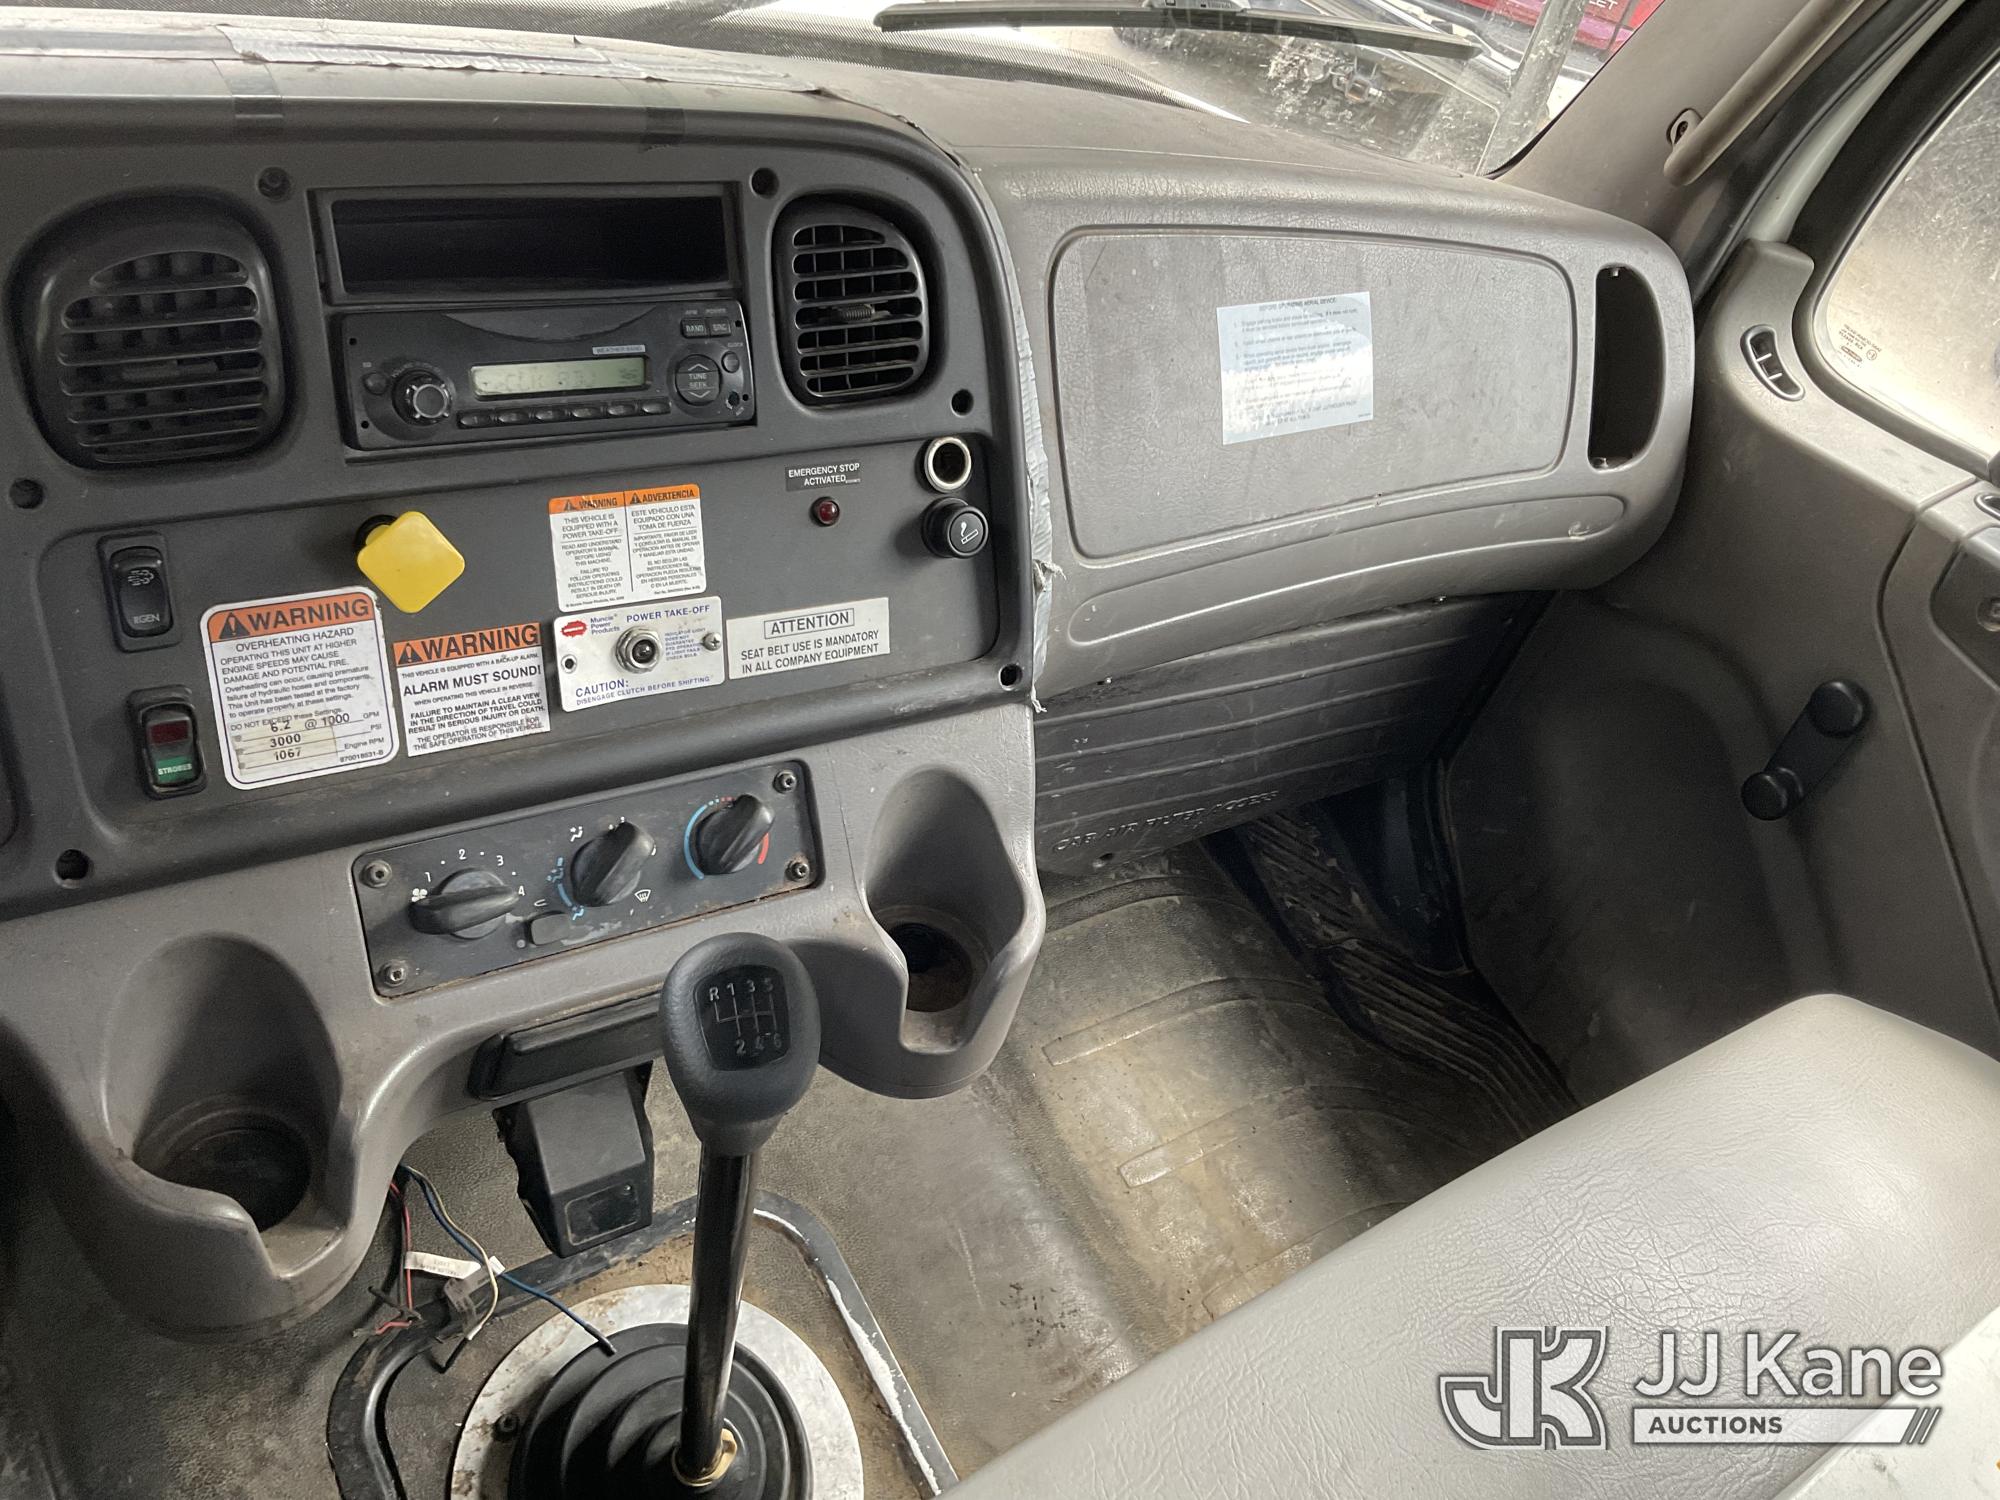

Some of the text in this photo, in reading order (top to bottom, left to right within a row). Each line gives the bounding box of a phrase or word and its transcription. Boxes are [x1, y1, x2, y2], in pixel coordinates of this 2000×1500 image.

[788, 463, 859, 477] EMERGENCY STOP
[804, 475, 846, 486] ACTIVATED
[643, 490, 695, 502] ADVERTENCIA
[580, 514, 607, 522] VEHICLE
[634, 515, 665, 524] EQUIPADO
[649, 506, 679, 515] VEHICULO
[562, 523, 594, 532] EQUIPPED
[563, 527, 618, 539] POWER TAKE-OFF
[668, 519, 691, 527] FUERZA
[248, 599, 369, 631] WARNING
[626, 605, 710, 623] POWER TAKE-OFF
[771, 612, 849, 635] ATTENTION
[236, 626, 354, 654] OVERHEATING HAZARD
[591, 626, 620, 635] Products
[221, 637, 357, 666] OPERATING THIS UNIT AT HIGHER
[421, 625, 539, 660] WARNING
[741, 630, 878, 661] SEAT BELT USE IS MANDATORY
[222, 650, 339, 675] ENGINE SPEEDS MAY CAUSE
[415, 668, 439, 676] VEHICLE
[447, 662, 475, 671] EQUIPPED
[496, 656, 519, 664] BACK-UP
[742, 643, 879, 674] IN ALL COMPANY EQUIPMENT
[224, 658, 348, 685] DAMAGE AND POTENTIAL FIRE.
[226, 680, 267, 695] Overheating
[306, 670, 333, 682] causing
[335, 664, 368, 677] premature
[403, 665, 541, 697] ALARM MUST SOUND!
[228, 683, 360, 710] This Unit has been tested at the factory
[575, 678, 629, 697] CAUTION:
[577, 676, 710, 706] DISENGAGE CLUTCH BEFORE SHIFTING
[411, 708, 440, 720] FAILURE
[442, 706, 452, 714] TO
[455, 700, 489, 712] MAINTAIN
[498, 695, 521, 705] CLEAR
[523, 691, 540, 701] VIEW
[420, 716, 434, 725] THE
[436, 709, 476, 722] DIRECTION
[478, 707, 488, 715] OF
[490, 703, 516, 713] TRAVEL
[518, 698, 542, 708] COULD
[231, 722, 242, 731] DO
[245, 719, 259, 729] NOT
[262, 714, 292, 726] EXCEED
[294, 710, 312, 720] these
[271, 711, 379, 732] 6.2 @ 1000 GPM
[409, 723, 435, 734] RESULT
[448, 716, 479, 727] SERIOUS
[481, 711, 506, 722] INJURY
[508, 709, 519, 717] OR
[418, 717, 539, 744] THE OPERATOR IS RESPONSIBLE FOR
[270, 734, 301, 748] 3000
[274, 737, 384, 760] 1067 Engine RPM
[414, 742, 428, 751] THE
[428, 739, 447, 748] SAFE
[448, 732, 487, 745] OPERATION
[488, 730, 498, 738] OF
[499, 727, 514, 736] THIS
[459, 849, 466, 860] 2
[496, 855, 504, 866] 3
[425, 872, 431, 882] 1
[518, 886, 525, 896] 4
[709, 987, 719, 1001] R
[726, 983, 734, 995] 1
[747, 980, 755, 992] 3
[736, 1039, 746, 1054] 2
